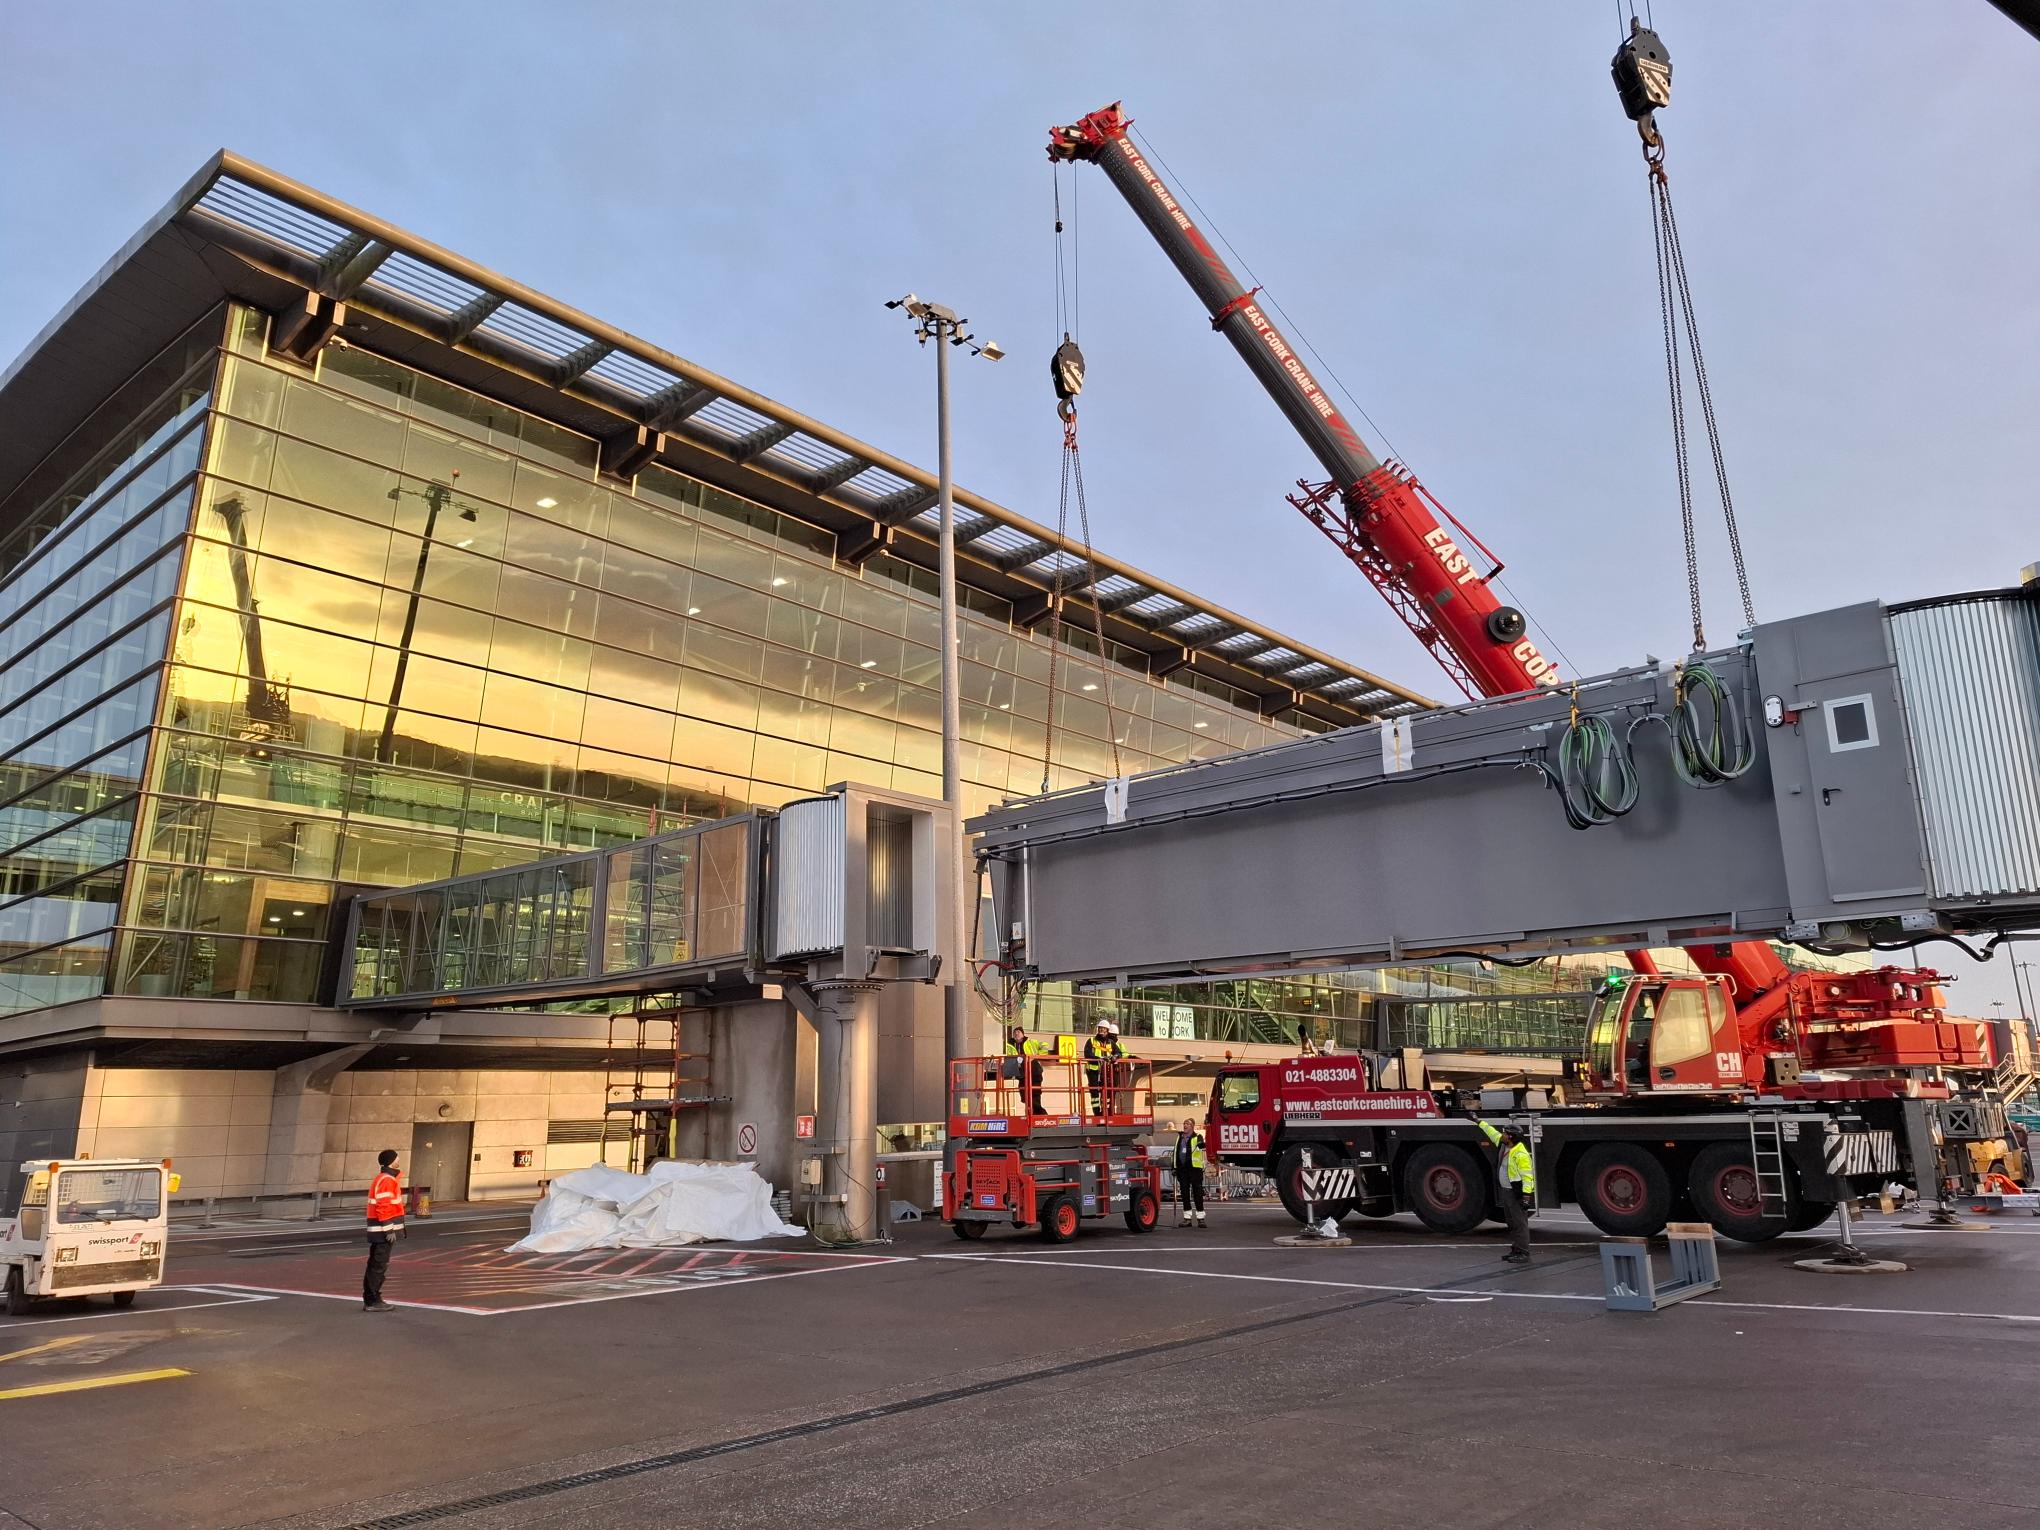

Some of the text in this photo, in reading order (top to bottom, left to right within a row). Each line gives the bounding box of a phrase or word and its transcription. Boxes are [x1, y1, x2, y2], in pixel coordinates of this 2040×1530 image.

[1118, 138, 1191, 230] EAST CORK CRANE HIRE
[1244, 305, 1334, 418] EAST CORK CRANE HIRE
[1424, 527, 1480, 585] EAST
[1159, 1026, 1167, 1036] to
[1285, 1068, 1357, 1083] 021-4883304
[1285, 1096, 1428, 1111] www.eastcorkcranehire.ie
[1220, 1125, 1259, 1143] ECCH
[88, 1236, 129, 1245] swissport
